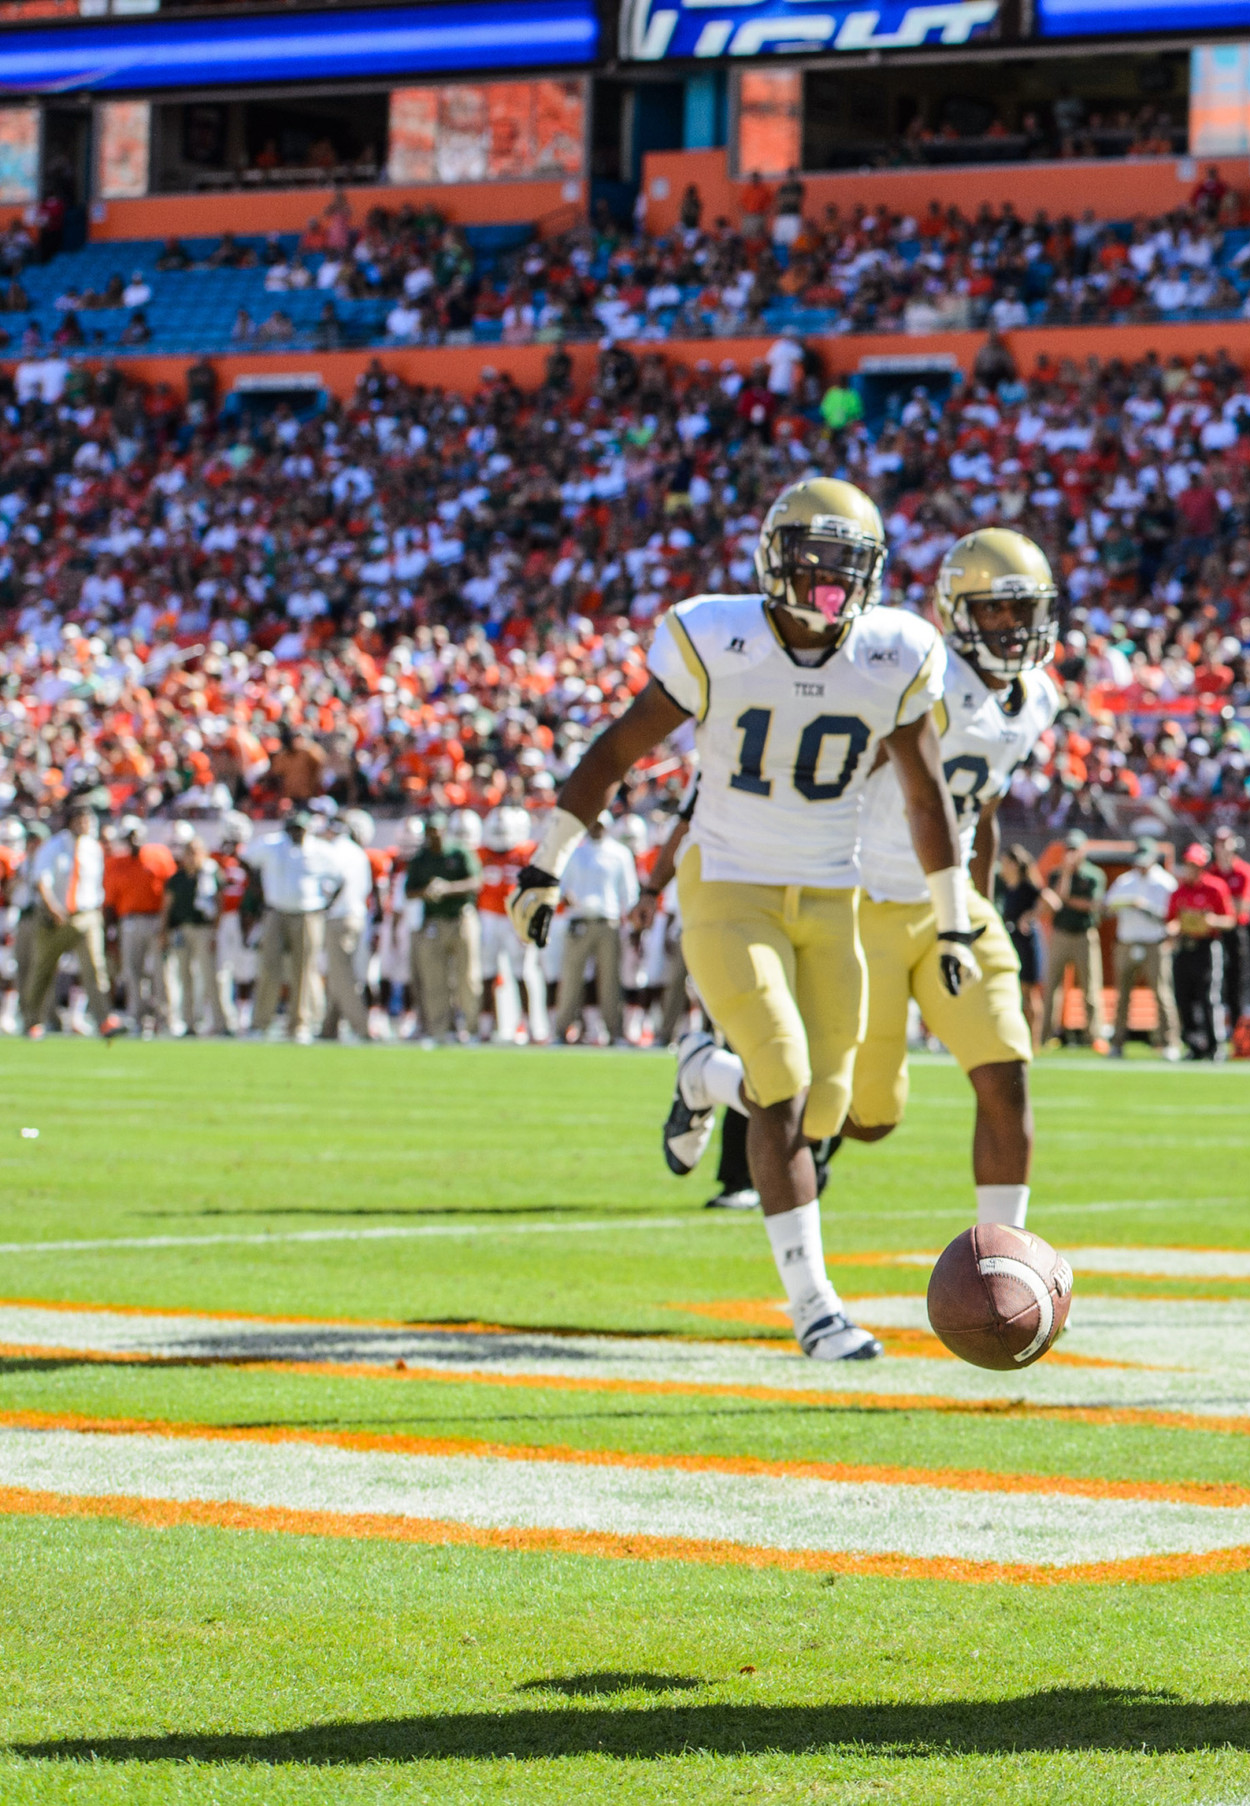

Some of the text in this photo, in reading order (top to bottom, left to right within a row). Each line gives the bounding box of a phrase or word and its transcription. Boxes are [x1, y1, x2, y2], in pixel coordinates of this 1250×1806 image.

[870, 649, 899, 662] ACC
[793, 680, 825, 698] TECH
[726, 704, 874, 804] 10
